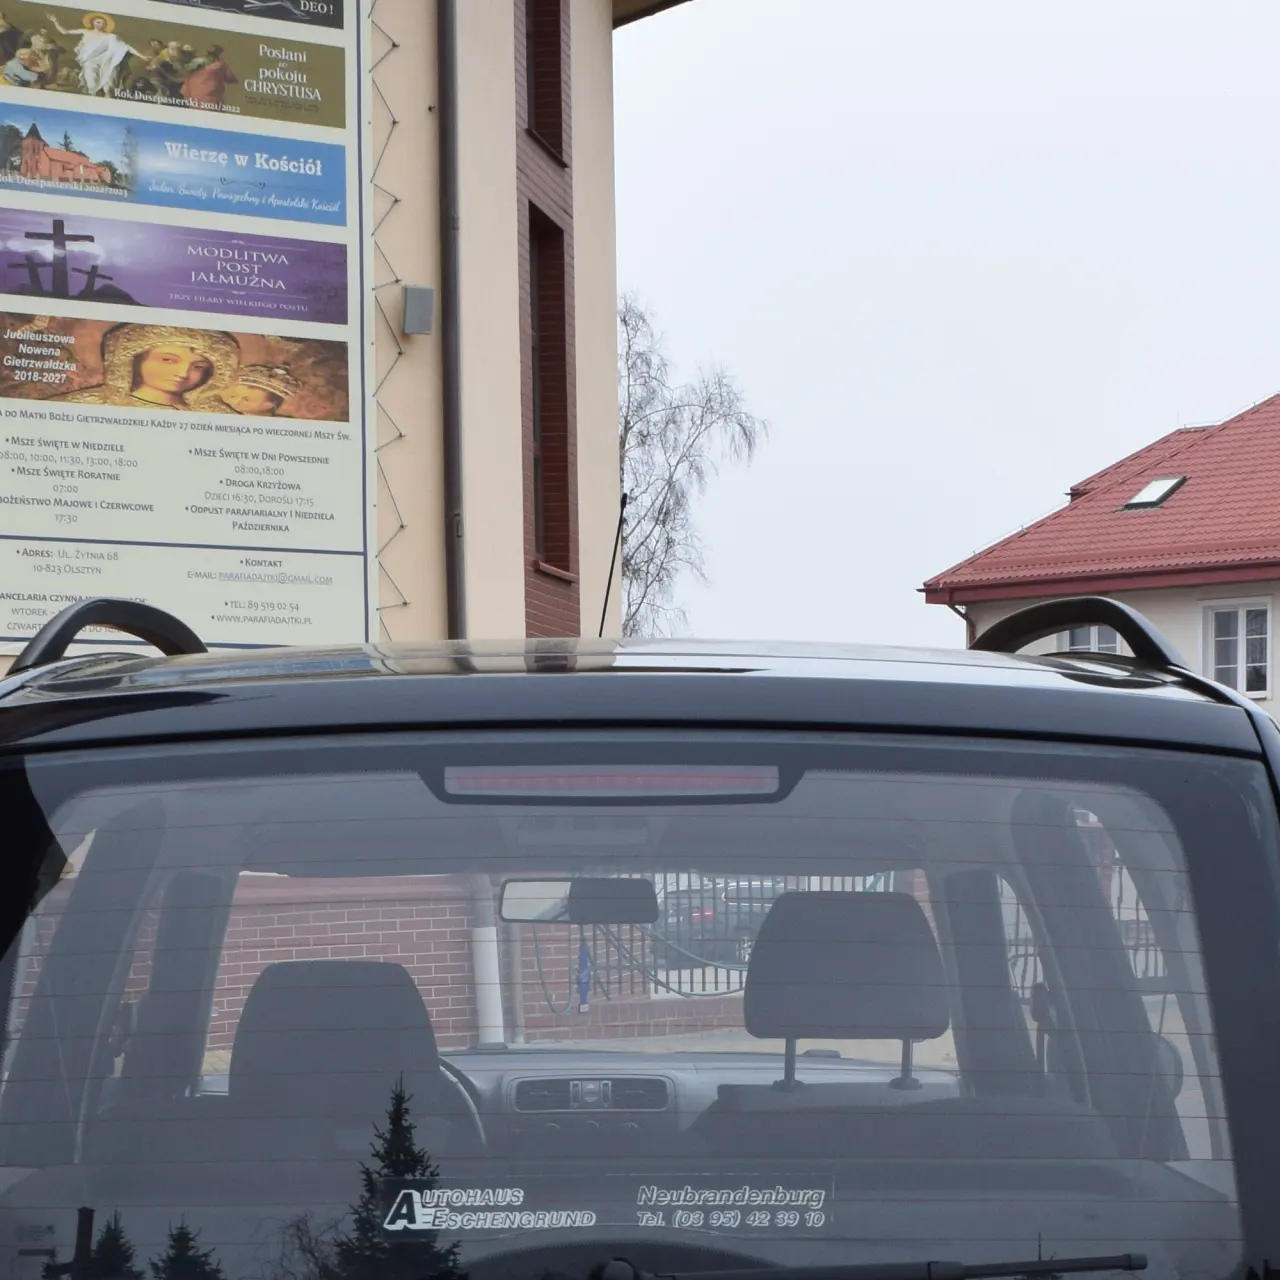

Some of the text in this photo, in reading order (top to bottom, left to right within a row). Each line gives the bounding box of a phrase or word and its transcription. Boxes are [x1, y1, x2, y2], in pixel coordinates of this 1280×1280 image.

[259, 67, 307, 84] pokoju
[244, 79, 322, 101] CHRYSTUSA
[114, 88, 134, 99] Rok
[134, 91, 198, 107] Duszpasterski
[200, 101, 241, 113] 2021/2022
[164, 142, 322, 176] Wierzę w Kościół
[187, 245, 289, 265] MODLITWA
[216, 260, 263, 275] POST
[191, 271, 287, 290] JAŁMUŻNA
[3, 329, 75, 344] Jubileuszowa
[18, 343, 61, 356] Nowena
[14, 370, 67, 383] 2018-2027
[179, 423, 188, 431] 27
[52, 484, 79, 494] 07:00
[106, 551, 119, 561] 68
[32, 564, 62, 575] 10-823
[247, 600, 259, 611] 89
[260, 602, 275, 612] 519
[277, 602, 287, 610] 02
[289, 602, 299, 612] 54
[636, 1185, 825, 1209] Neubrandenburg
[636, 1209, 825, 1227] Tel. (03 95) 42 39 10
